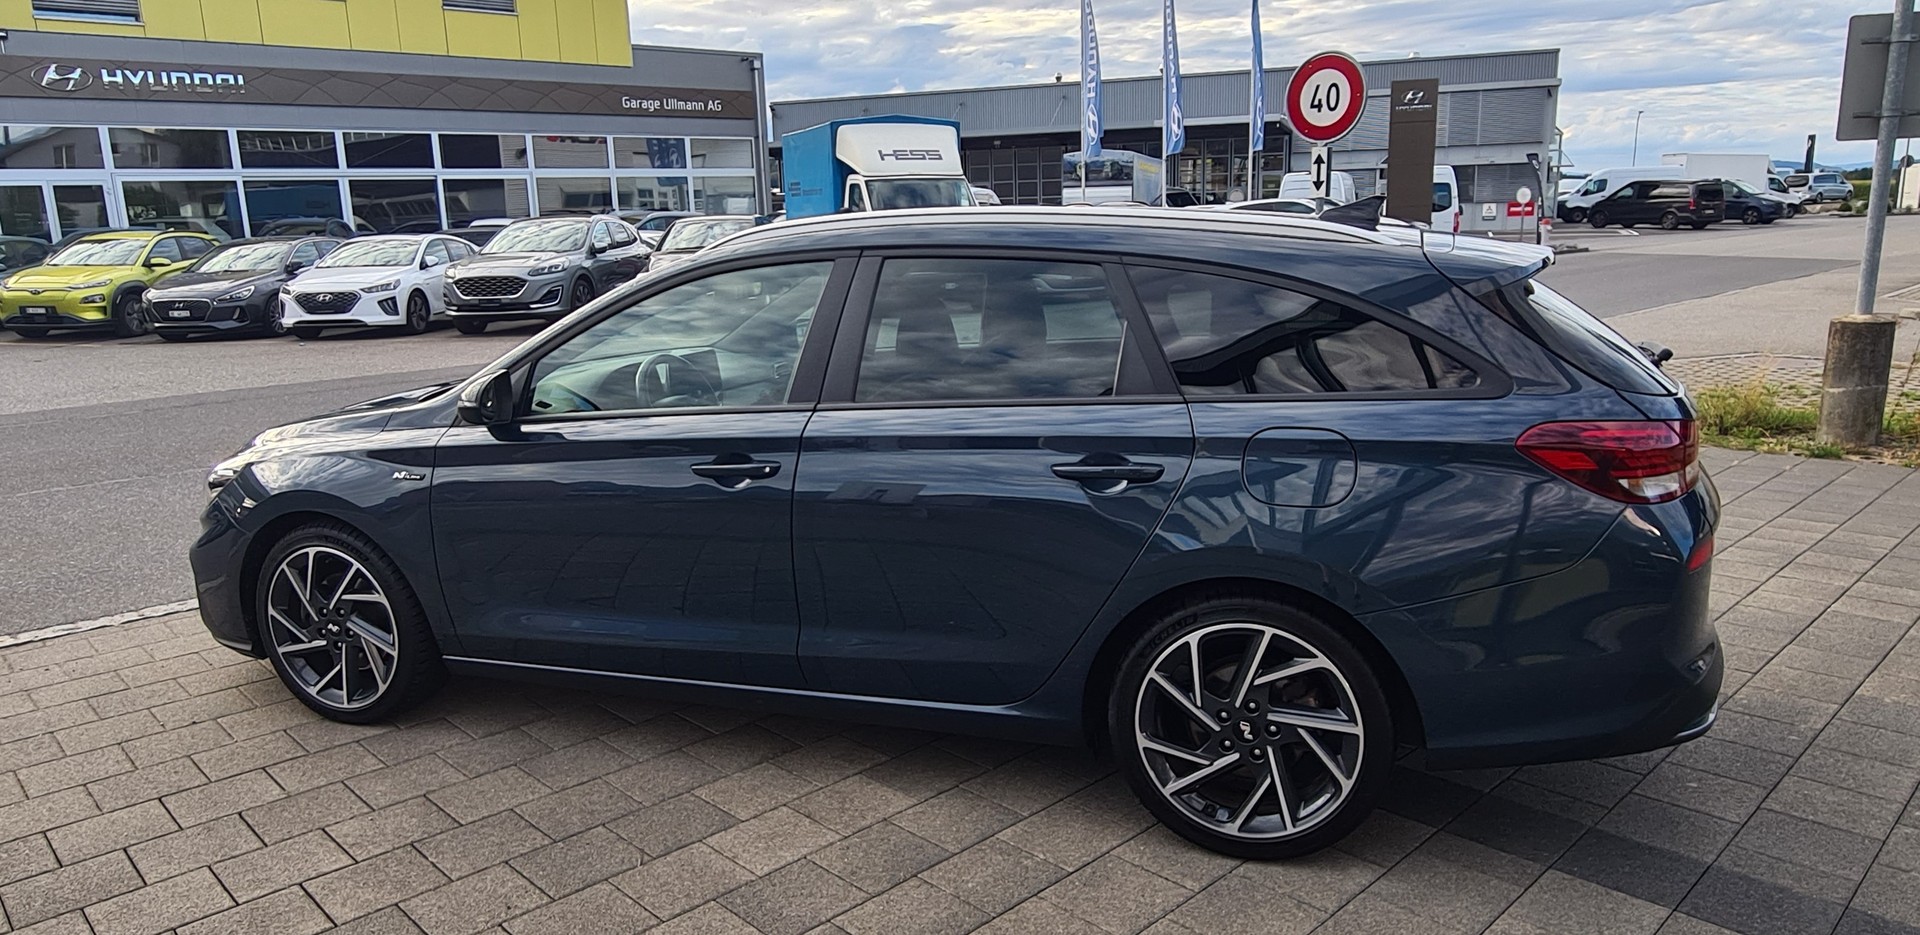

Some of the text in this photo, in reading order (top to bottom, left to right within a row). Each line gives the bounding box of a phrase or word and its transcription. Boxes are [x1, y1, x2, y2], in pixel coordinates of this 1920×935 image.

[100, 68, 246, 94] HYUNDAI
[621, 96, 722, 112] Garage Ullmann AG
[1310, 83, 1340, 113] 40
[877, 149, 943, 161] HESS
